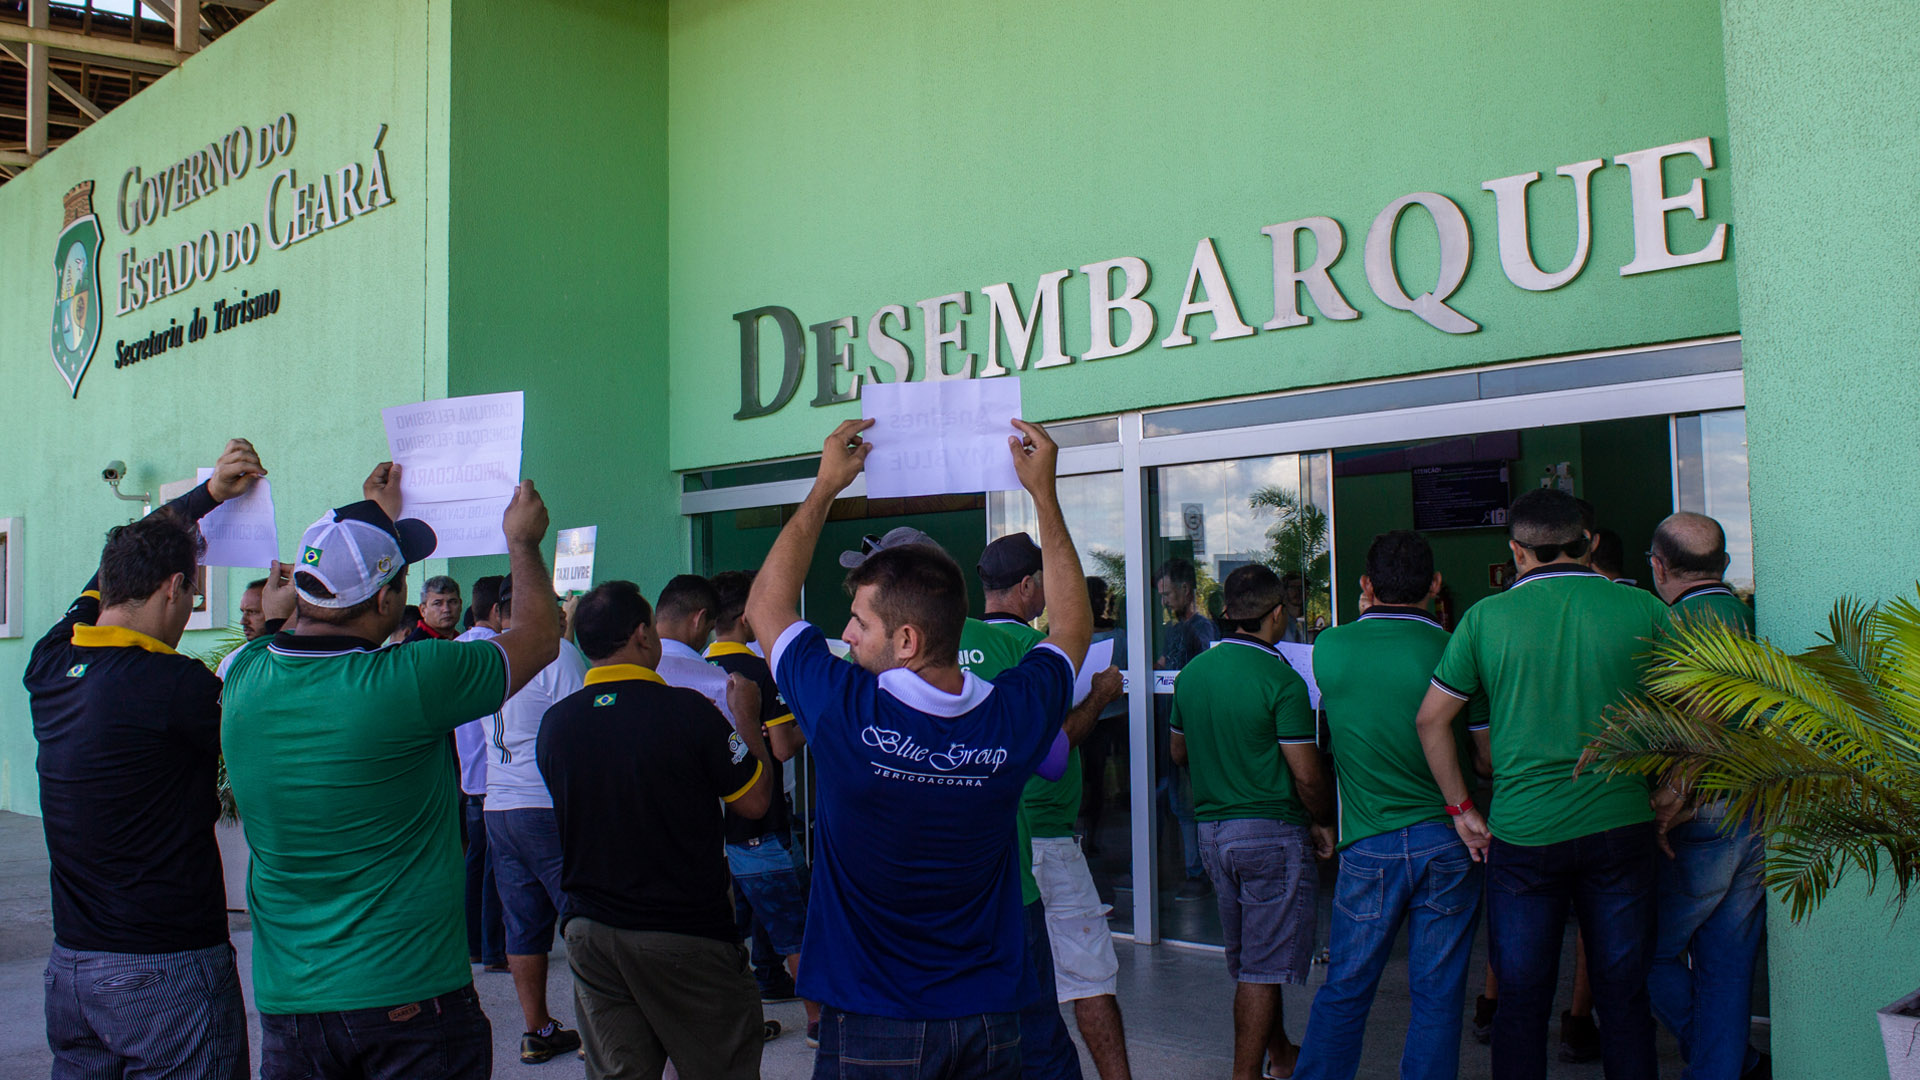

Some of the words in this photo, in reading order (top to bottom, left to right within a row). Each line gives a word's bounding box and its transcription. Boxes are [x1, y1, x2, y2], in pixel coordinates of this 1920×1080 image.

[117, 125, 253, 236] GOVERNO
[255, 112, 297, 168] DO
[115, 230, 220, 317] ESTADO
[221, 223, 261, 272] DO
[264, 123, 396, 251] CEARÁ
[733, 136, 1734, 421] DESEMBARQUE
[114, 318, 184, 369] Secretaria
[188, 307, 207, 343] do
[213, 289, 280, 334] Turismo
[556, 567, 570, 580] TAXI
[571, 566, 590, 579] LIVRE
[861, 725, 929, 763] Blue
[929, 742, 1008, 773] Group
[874, 768, 983, 787] JERICOACOARA
